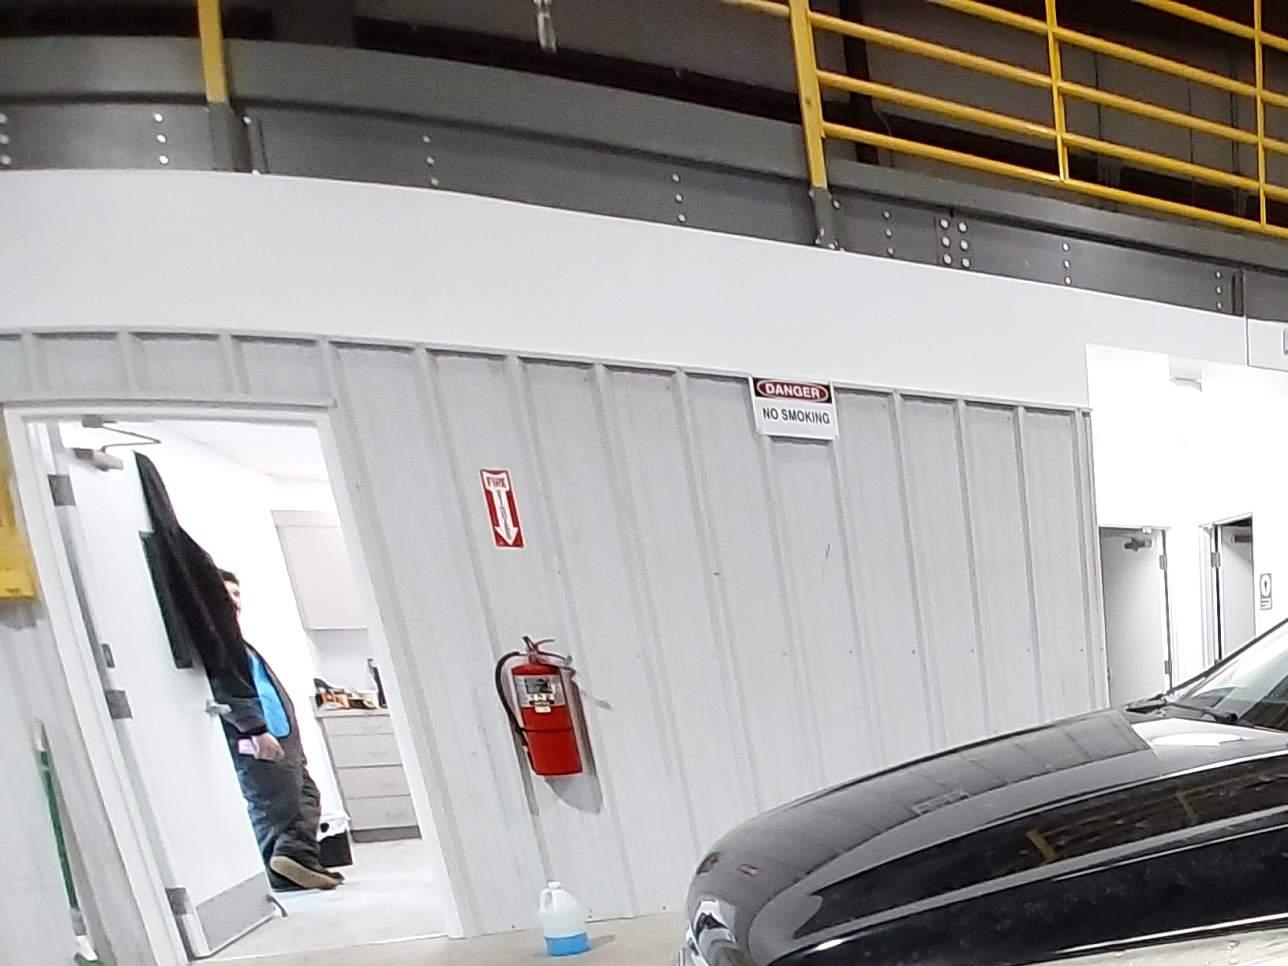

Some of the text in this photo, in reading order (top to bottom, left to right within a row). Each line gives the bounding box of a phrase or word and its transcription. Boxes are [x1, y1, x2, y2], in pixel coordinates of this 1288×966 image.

[765, 383, 820, 399] DANGER
[762, 407, 830, 425] NO SMOKING
